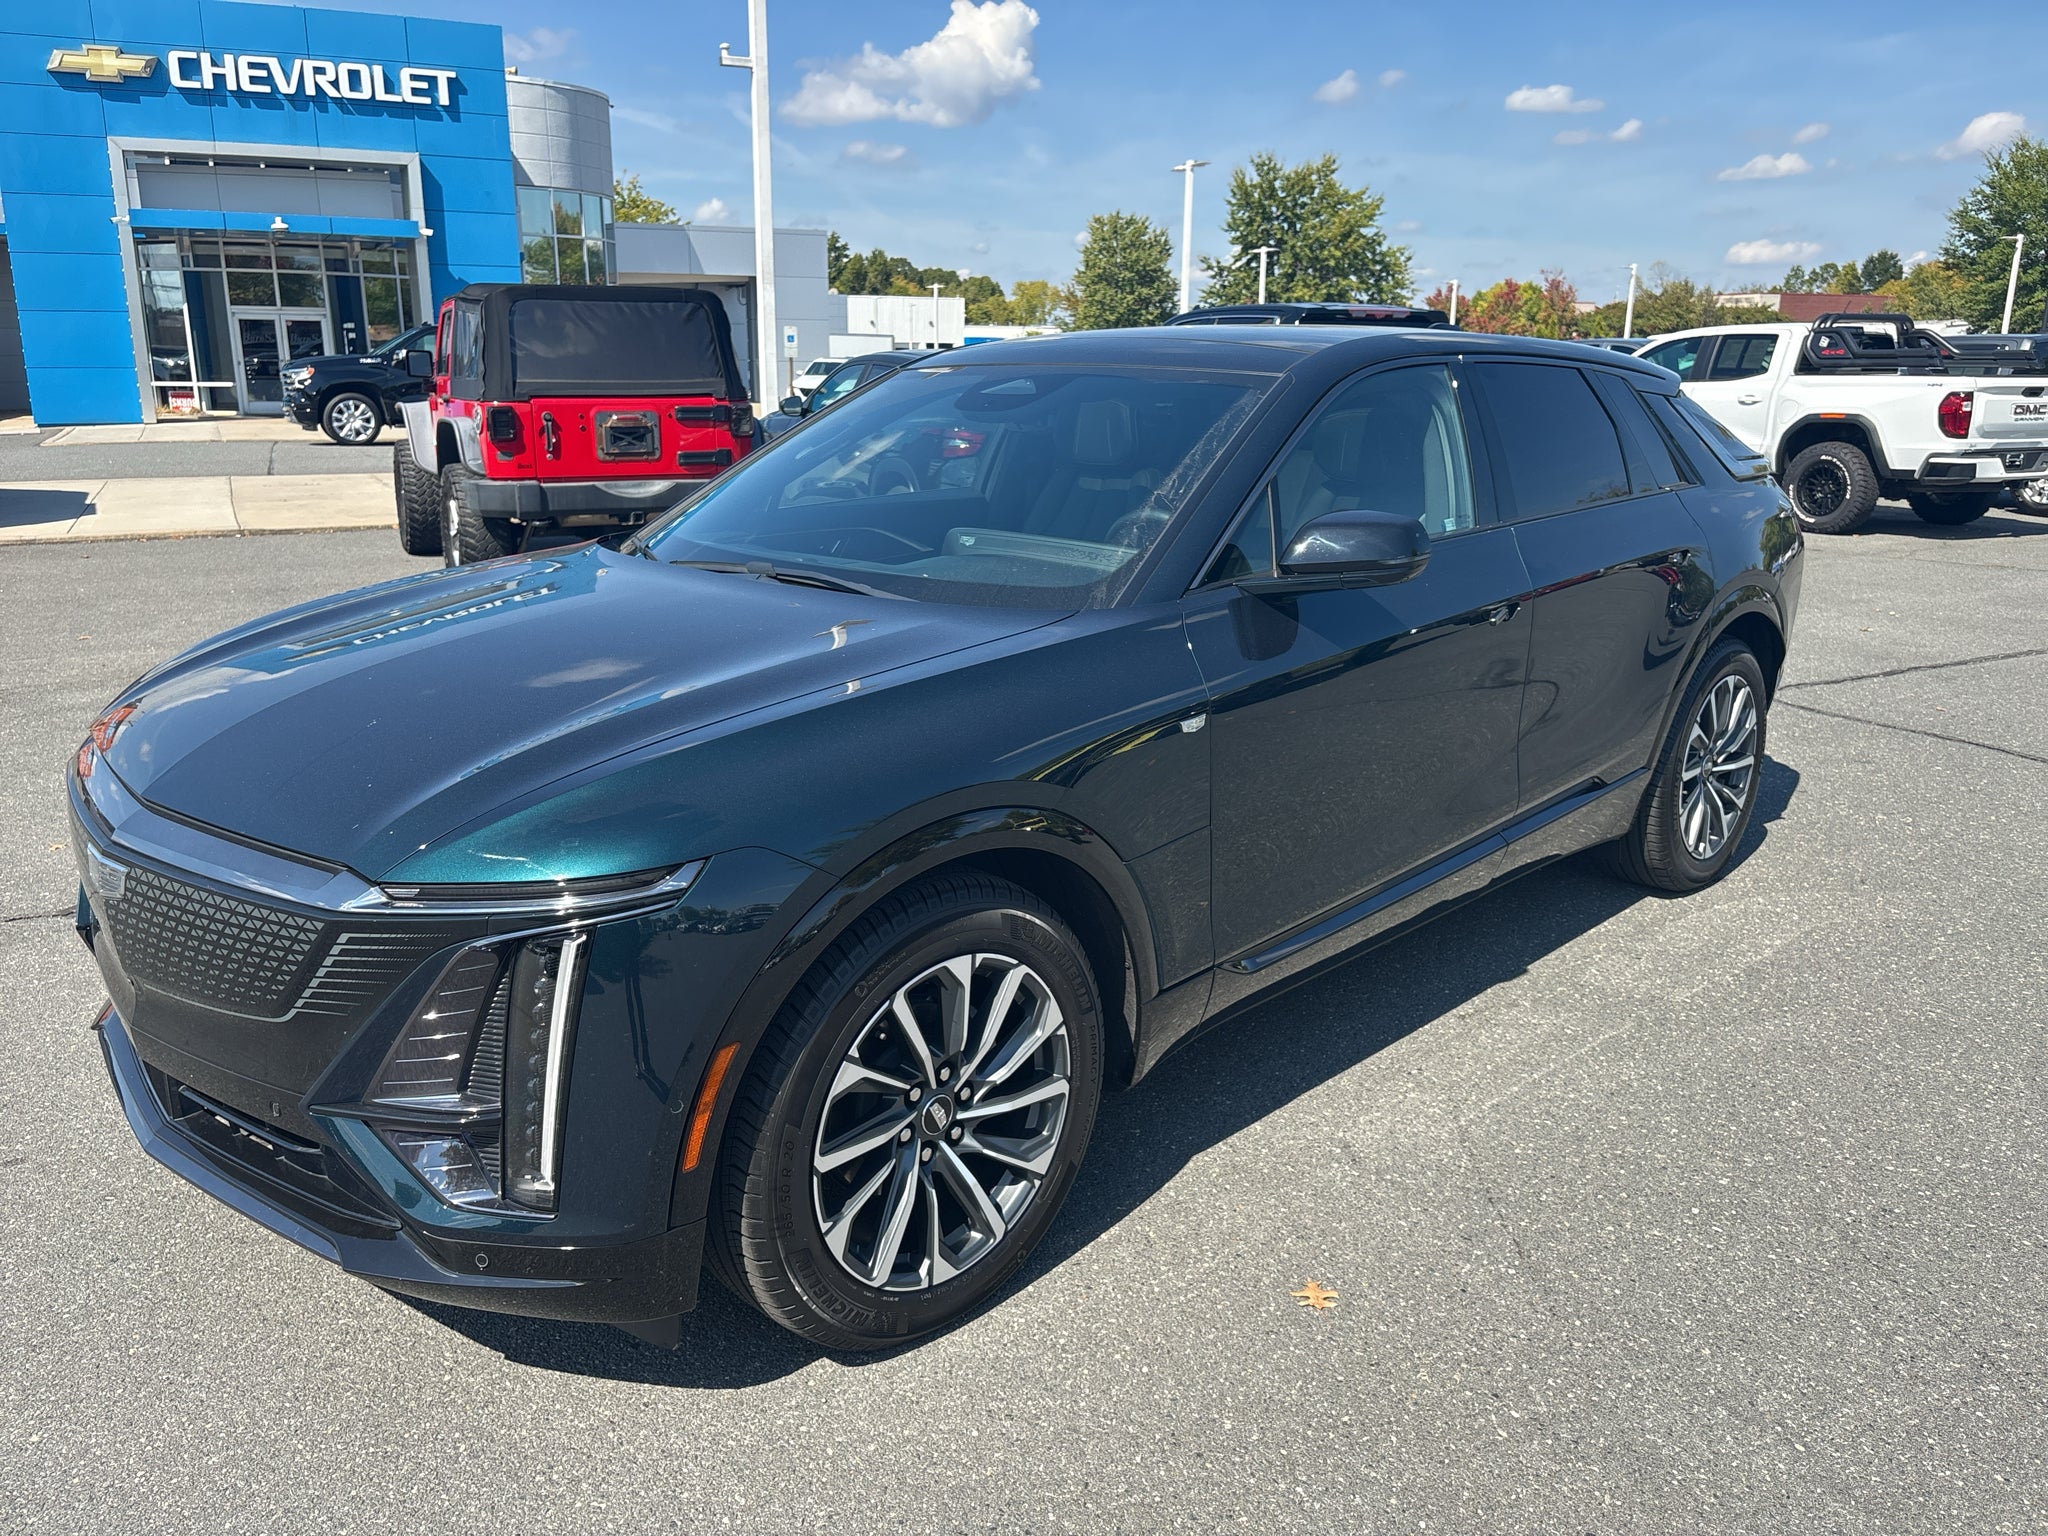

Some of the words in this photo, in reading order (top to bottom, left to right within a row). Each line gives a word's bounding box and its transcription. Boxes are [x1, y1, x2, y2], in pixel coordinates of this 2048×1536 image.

[167, 50, 457, 105] CHEVROLET
[2014, 405, 2047, 415] GMC
[1087, 1022, 1098, 1086] PRIMACY
[783, 1139, 796, 1162] 20
[795, 1248, 871, 1332] MICHELIN
